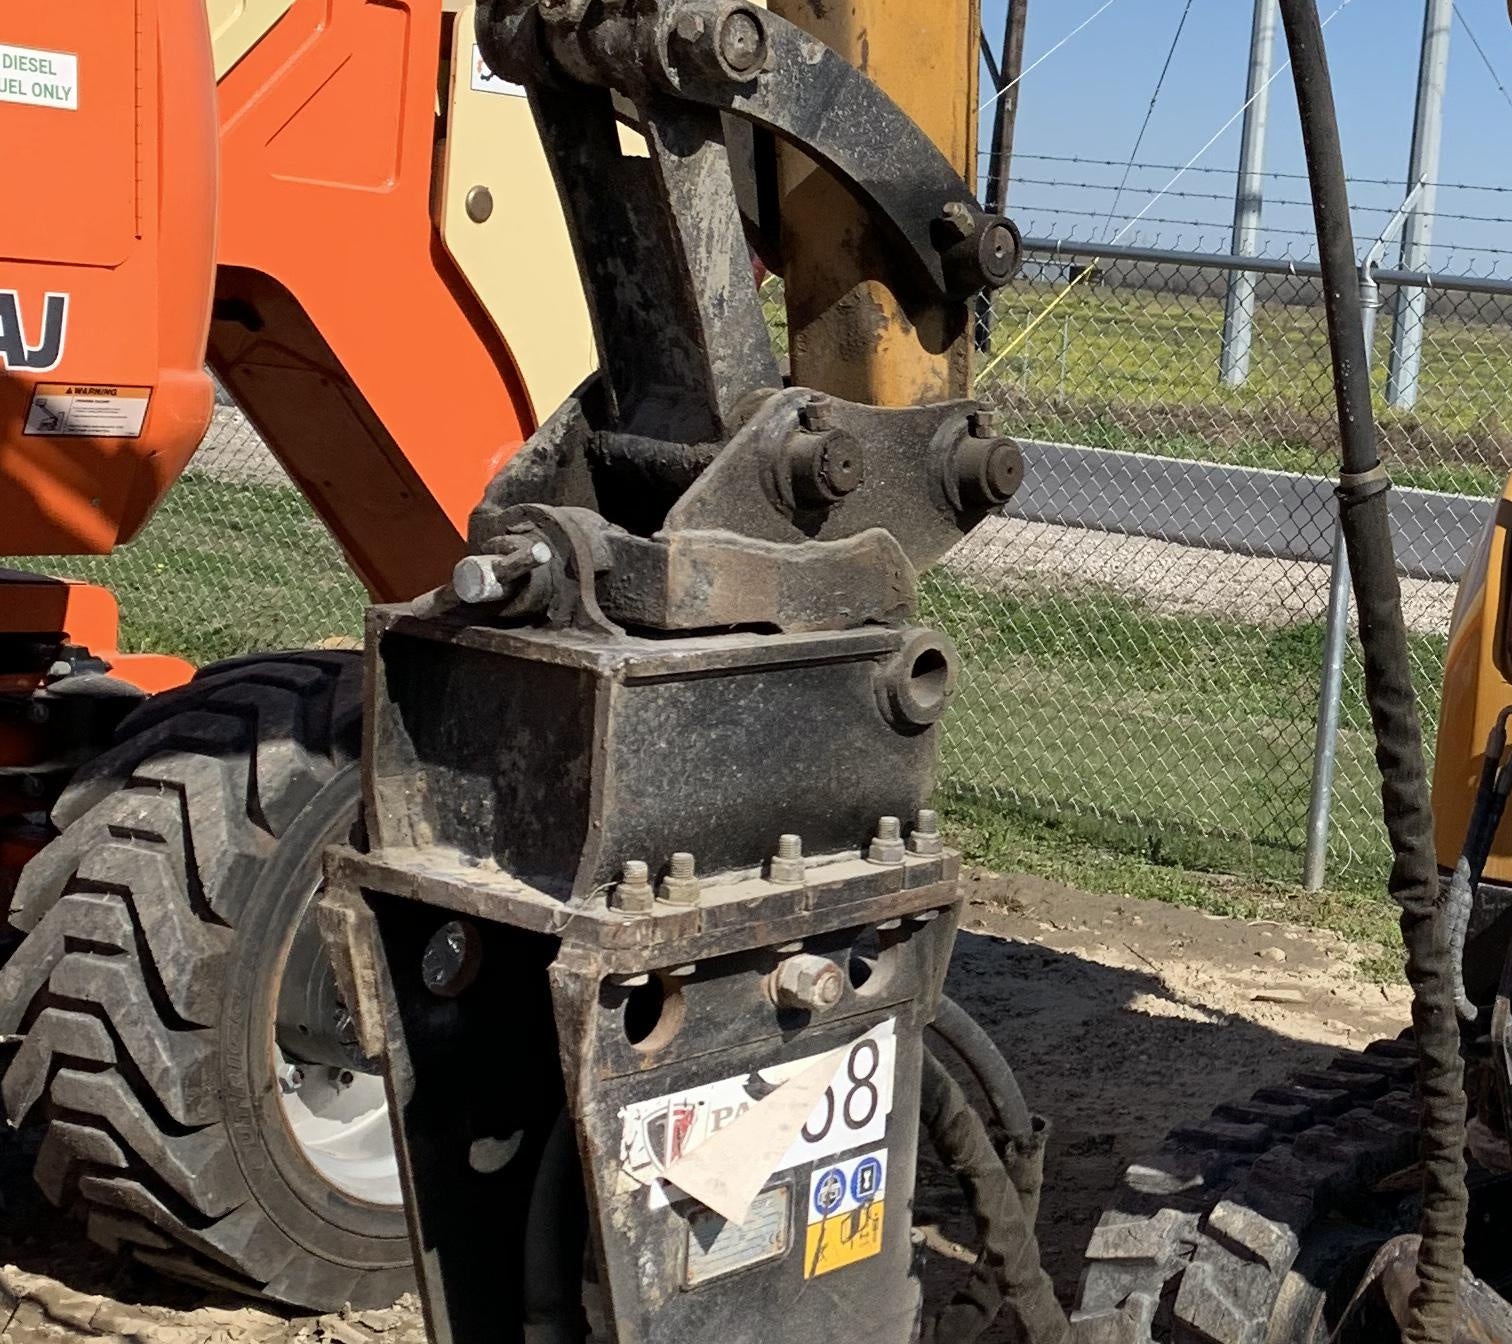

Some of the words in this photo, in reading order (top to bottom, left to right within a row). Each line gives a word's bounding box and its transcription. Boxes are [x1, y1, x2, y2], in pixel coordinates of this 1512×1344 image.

[3, 53, 57, 76] DIESEL
[0, 77, 27, 96] UEL
[32, 82, 72, 102] ONLY
[74, 387, 118, 396] WARNING
